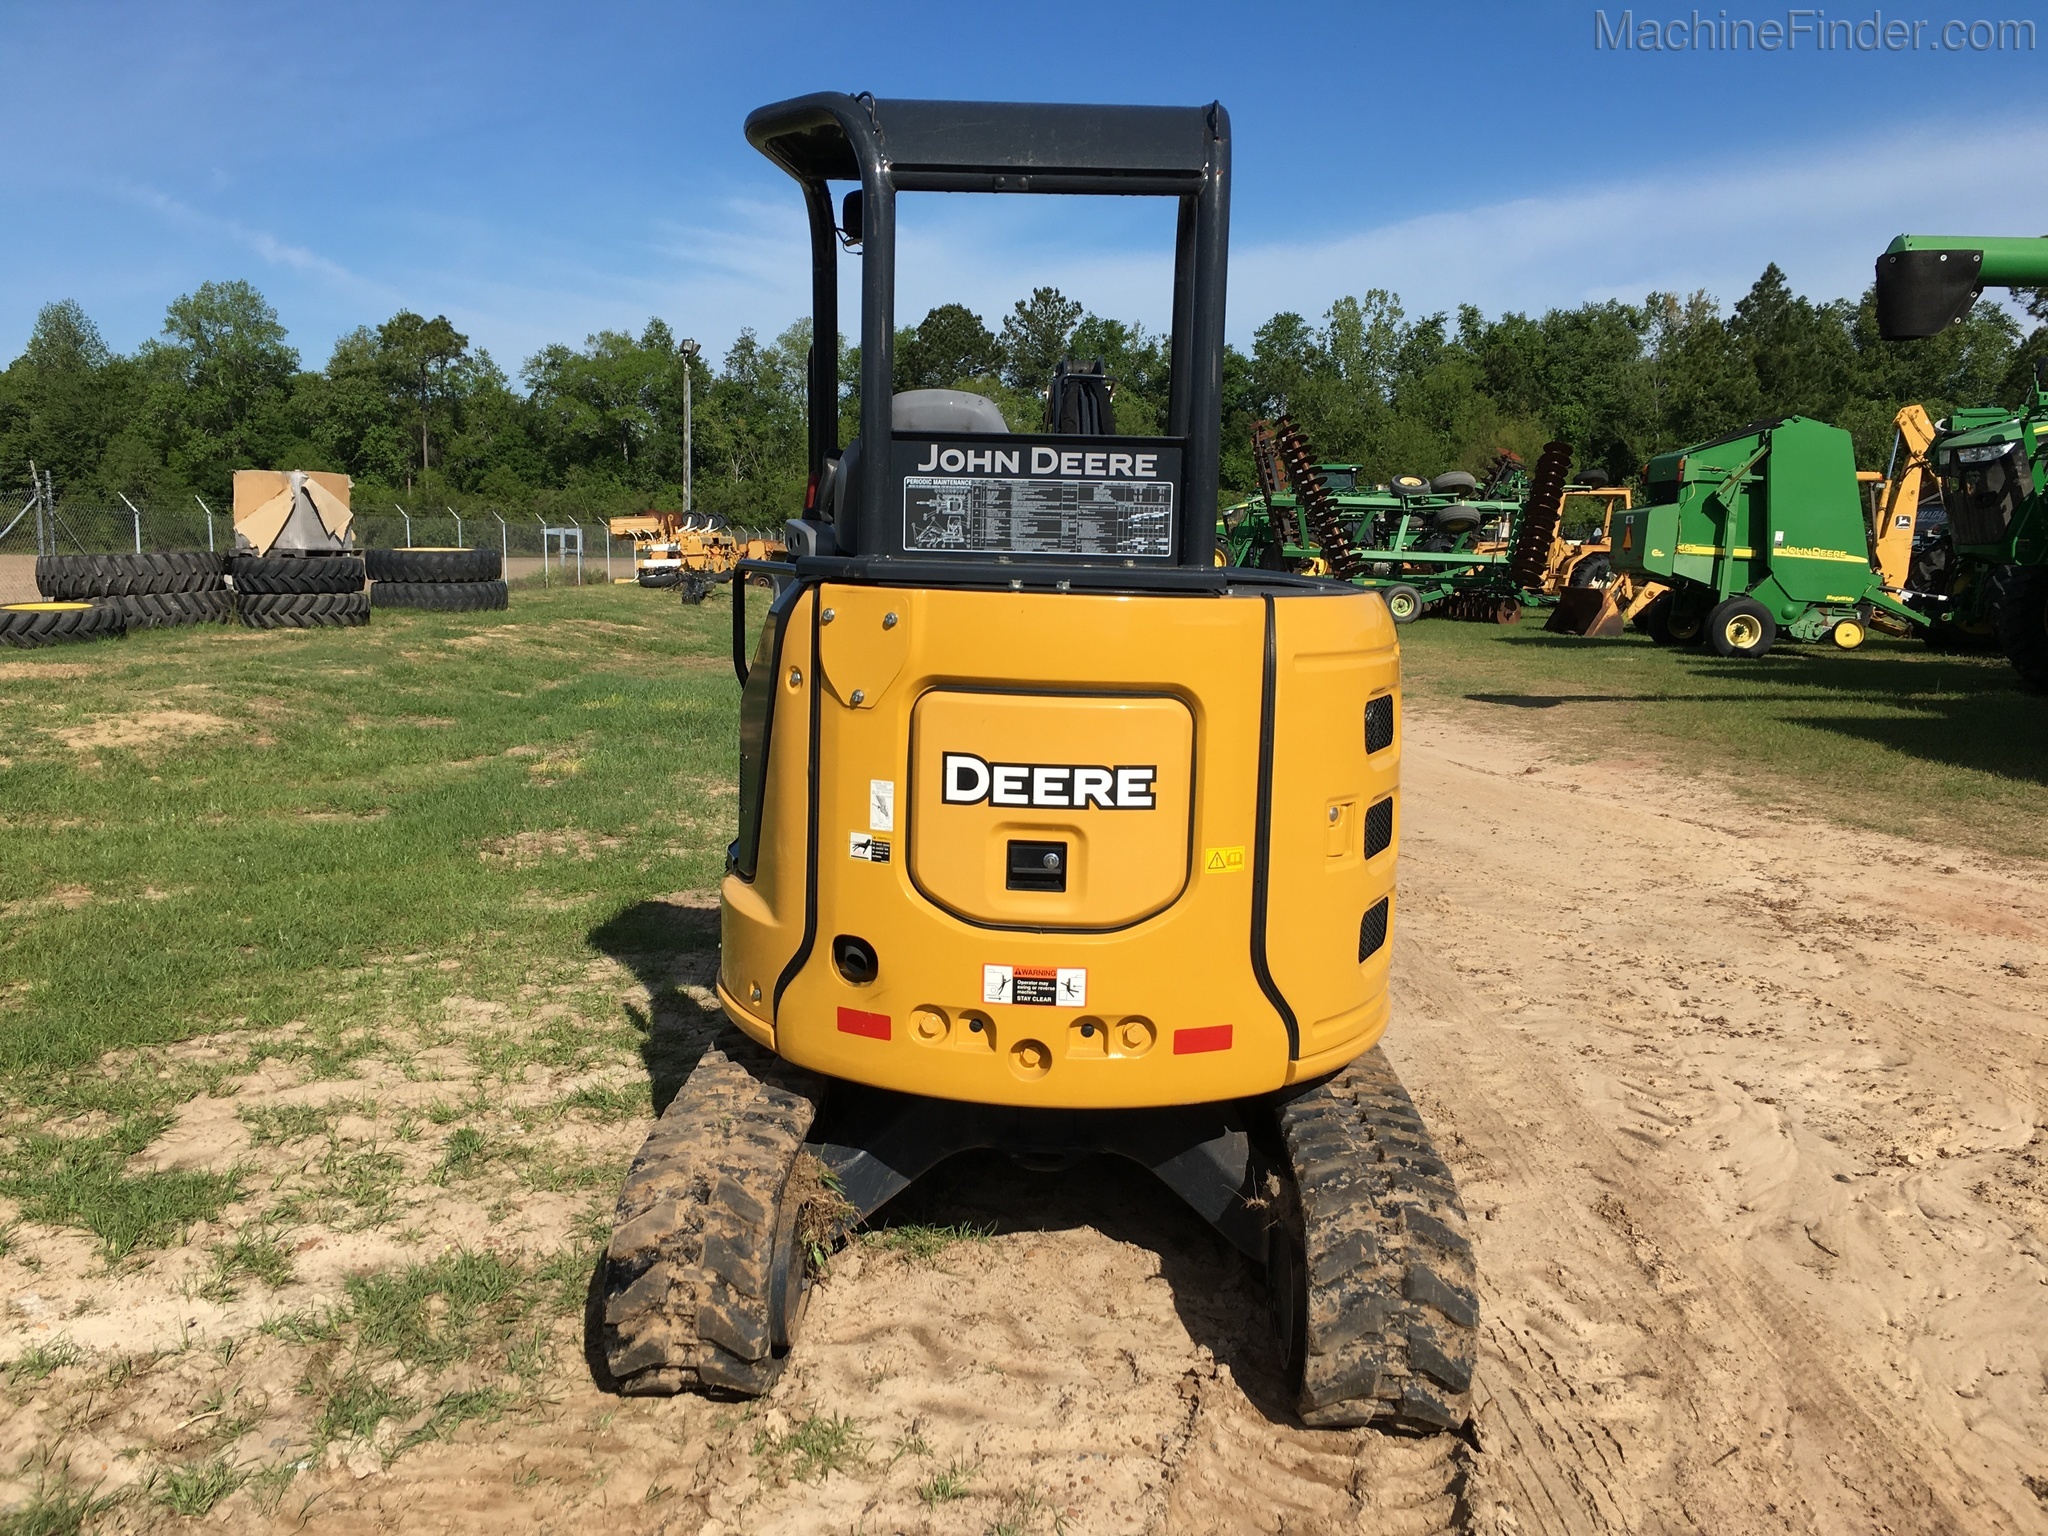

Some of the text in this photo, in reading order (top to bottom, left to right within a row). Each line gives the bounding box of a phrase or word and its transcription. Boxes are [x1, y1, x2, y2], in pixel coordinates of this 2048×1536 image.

[917, 444, 1158, 477] JOHN DEERE
[906, 478, 933, 486] PERIODIC
[933, 479, 972, 487] MAINTENANCE
[1782, 545, 1848, 559] JOHN DEERE
[944, 754, 1155, 808] DEERE
[1021, 969, 1056, 977] WARNING
[1017, 979, 1037, 987] Operator
